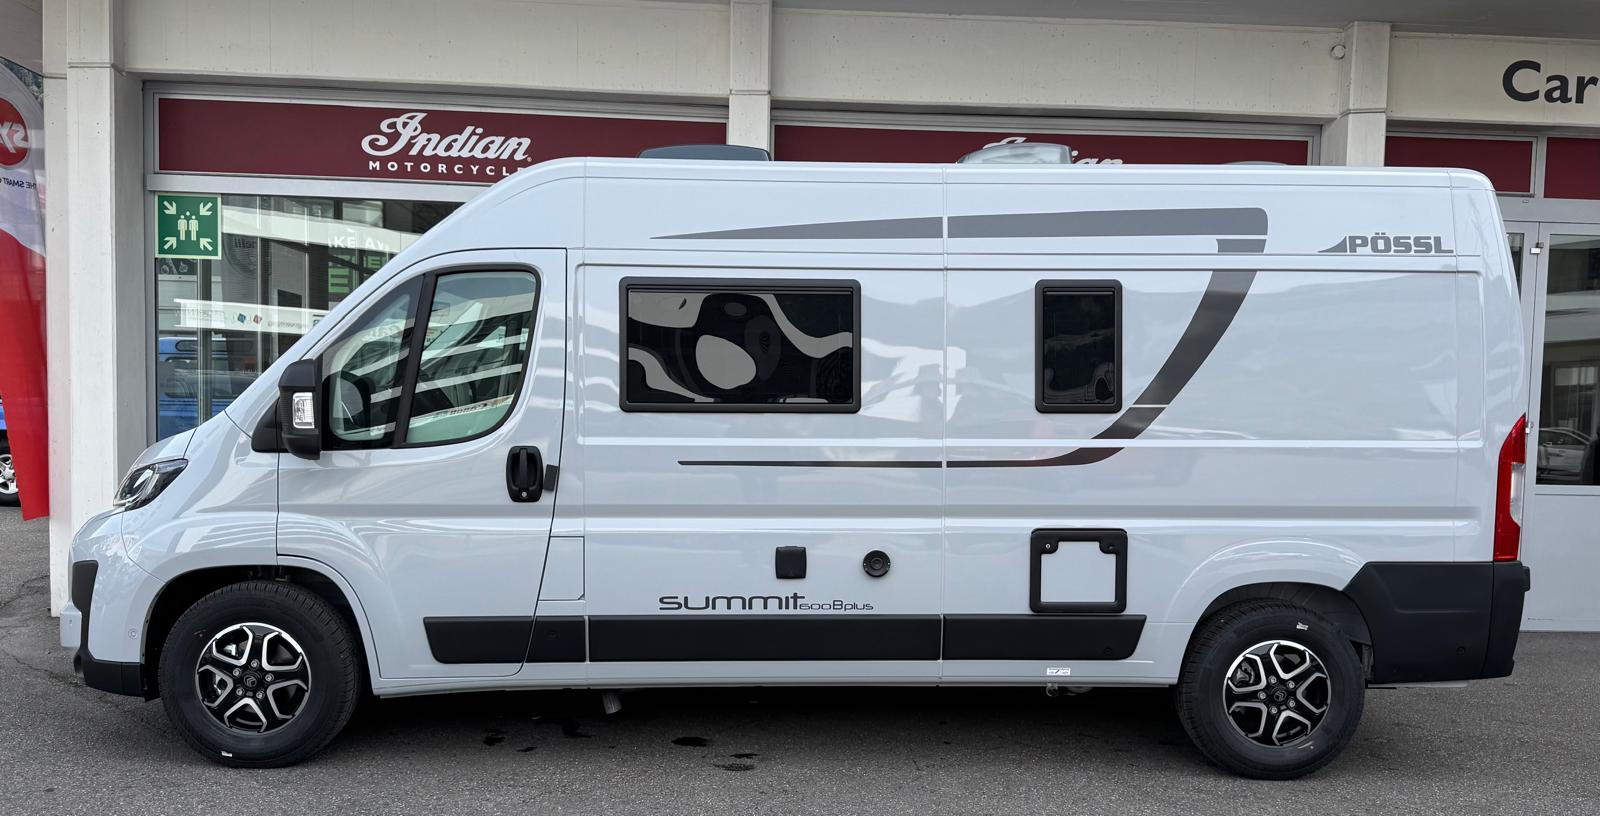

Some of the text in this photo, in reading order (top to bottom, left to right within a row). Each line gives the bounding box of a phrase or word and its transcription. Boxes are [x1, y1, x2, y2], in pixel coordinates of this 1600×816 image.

[1502, 60, 1599, 104] Car
[361, 112, 531, 161] Indian
[1348, 232, 1454, 254] PÖSSL
